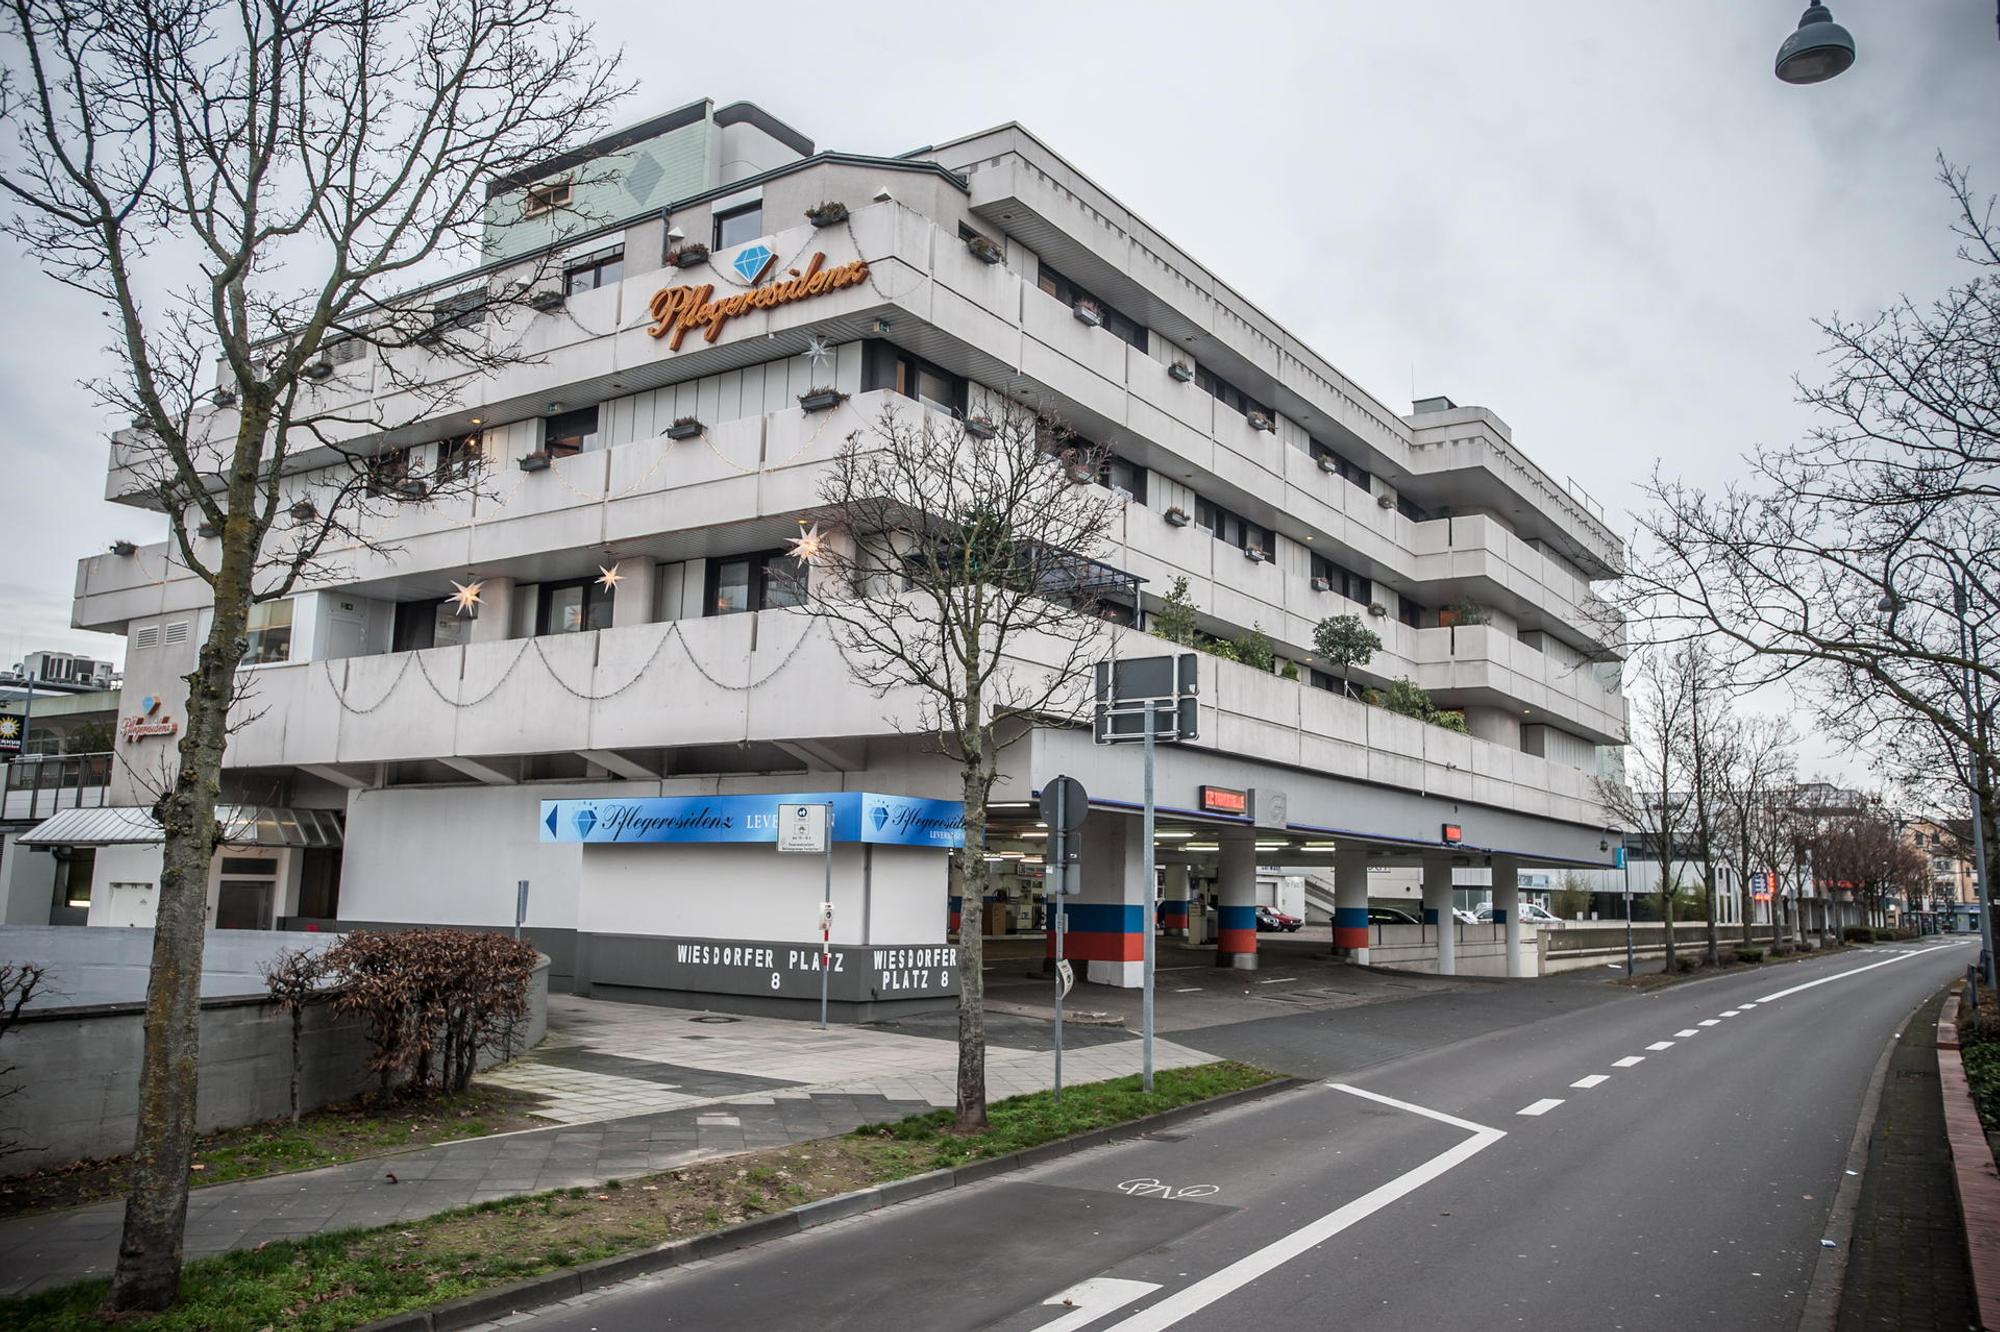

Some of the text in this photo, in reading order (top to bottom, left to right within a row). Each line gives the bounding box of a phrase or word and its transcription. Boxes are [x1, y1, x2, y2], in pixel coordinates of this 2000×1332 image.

[647, 251, 870, 352] Pflegeresidenz
[602, 804, 734, 841] Pflegeresidenz
[677, 944, 844, 972] WIESDORFER PLATZ
[873, 948, 957, 970] WIESDORFER
[770, 972, 781, 990] 8
[882, 969, 949, 990] PLATZ 8
